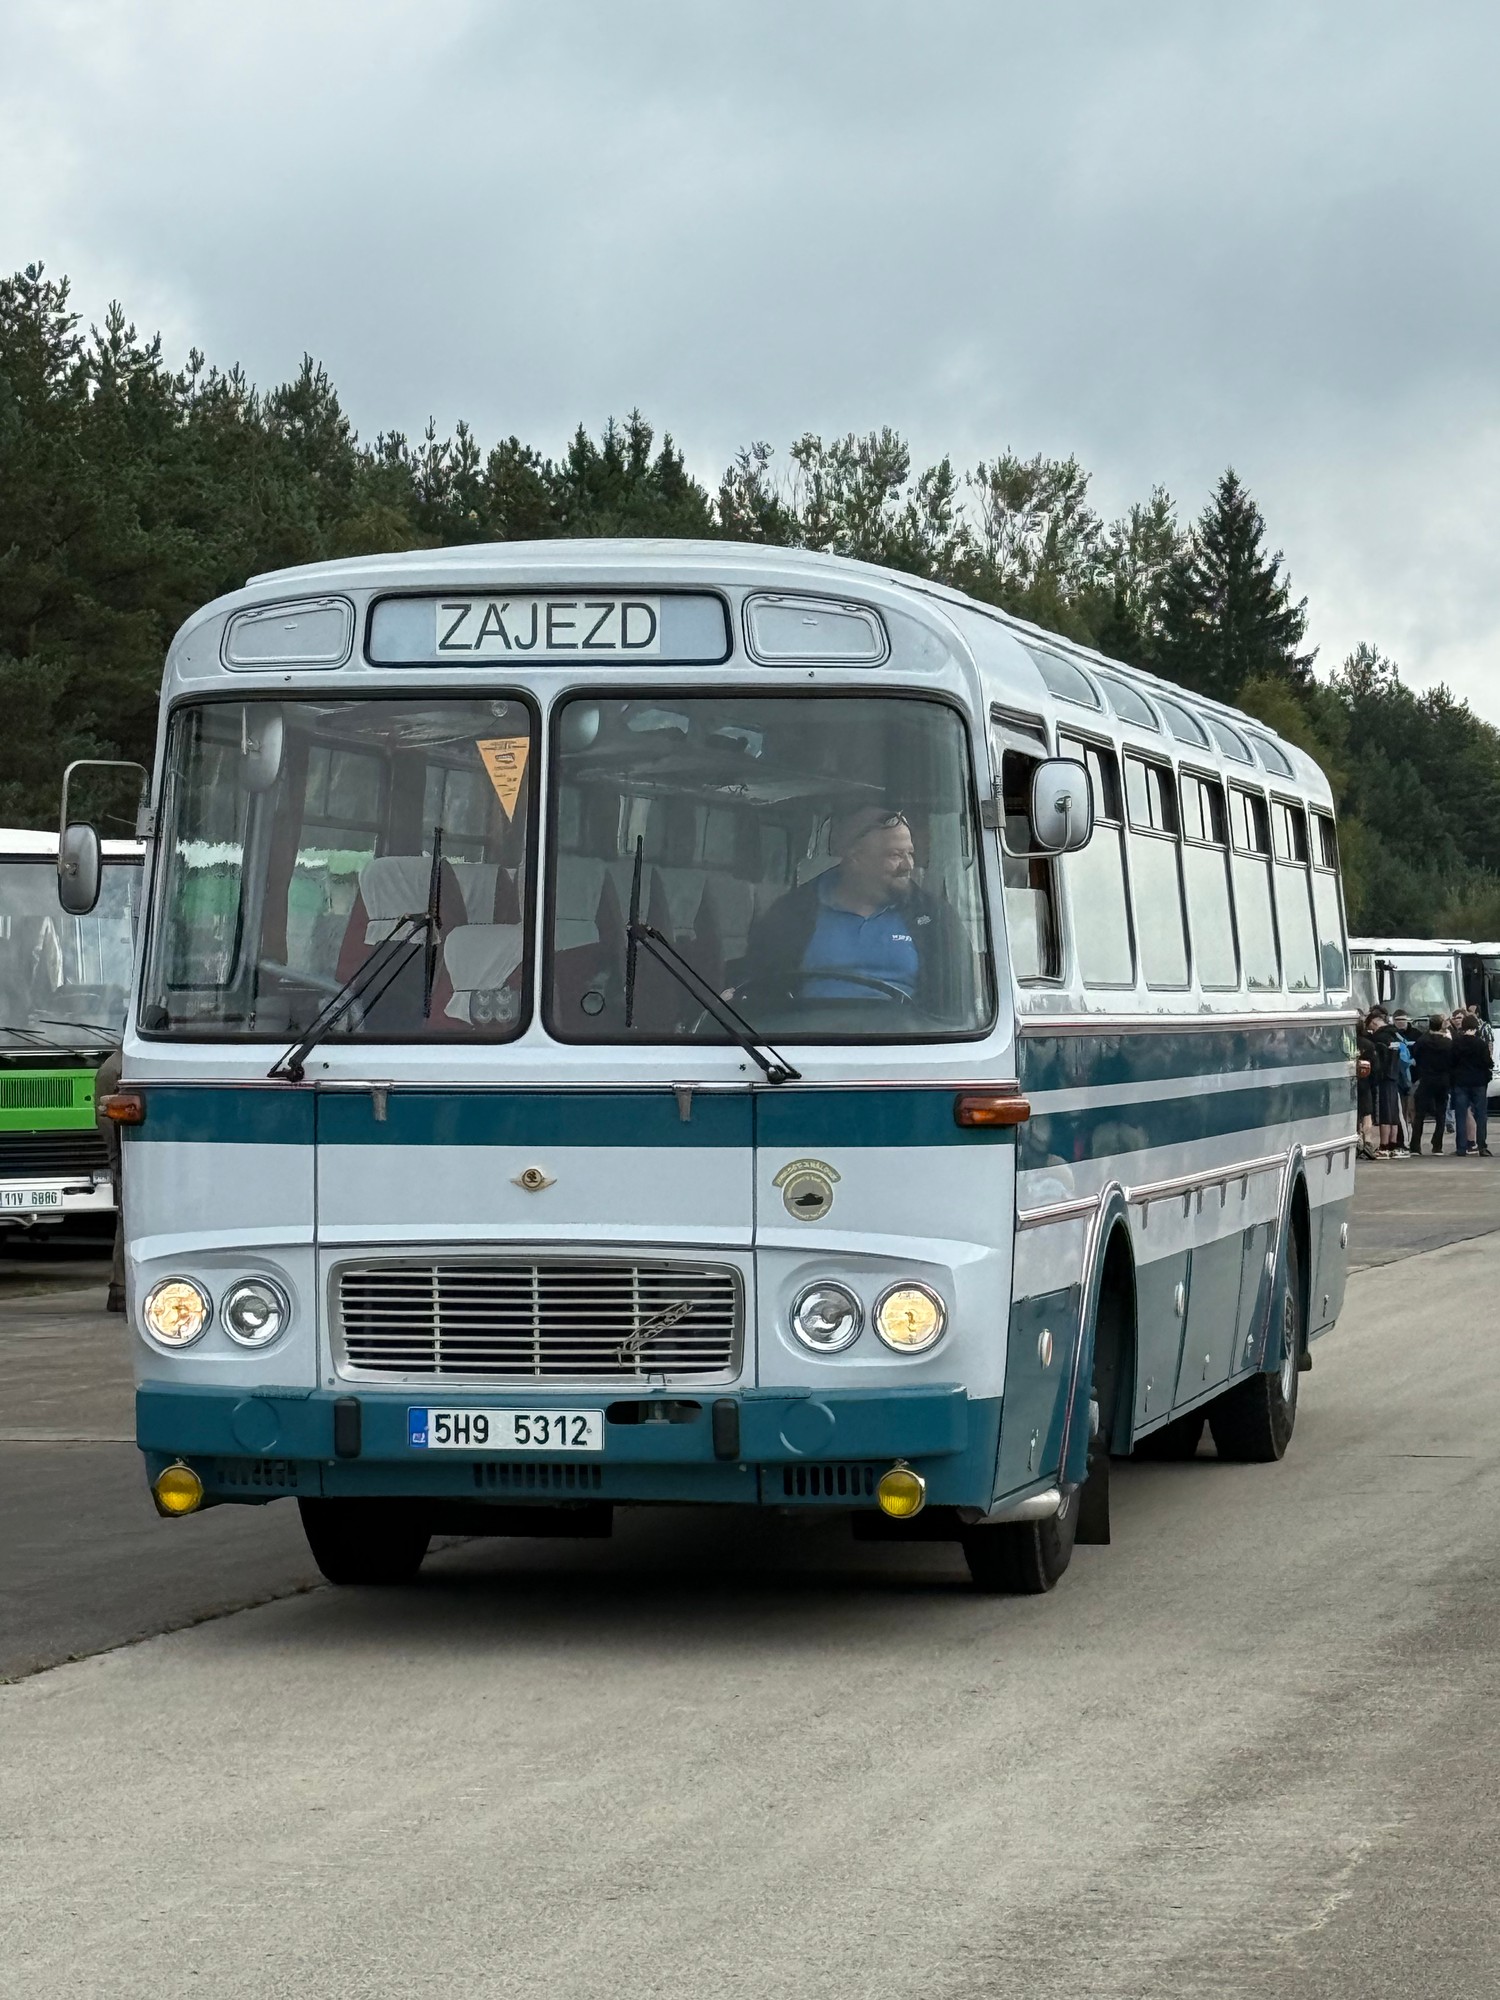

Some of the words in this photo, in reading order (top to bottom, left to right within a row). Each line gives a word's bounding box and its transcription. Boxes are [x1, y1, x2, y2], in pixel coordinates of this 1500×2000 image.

[438, 602, 657, 650] ZÁJEZD
[434, 1413, 490, 1444] 5H9
[514, 1414, 589, 1446] 5312
